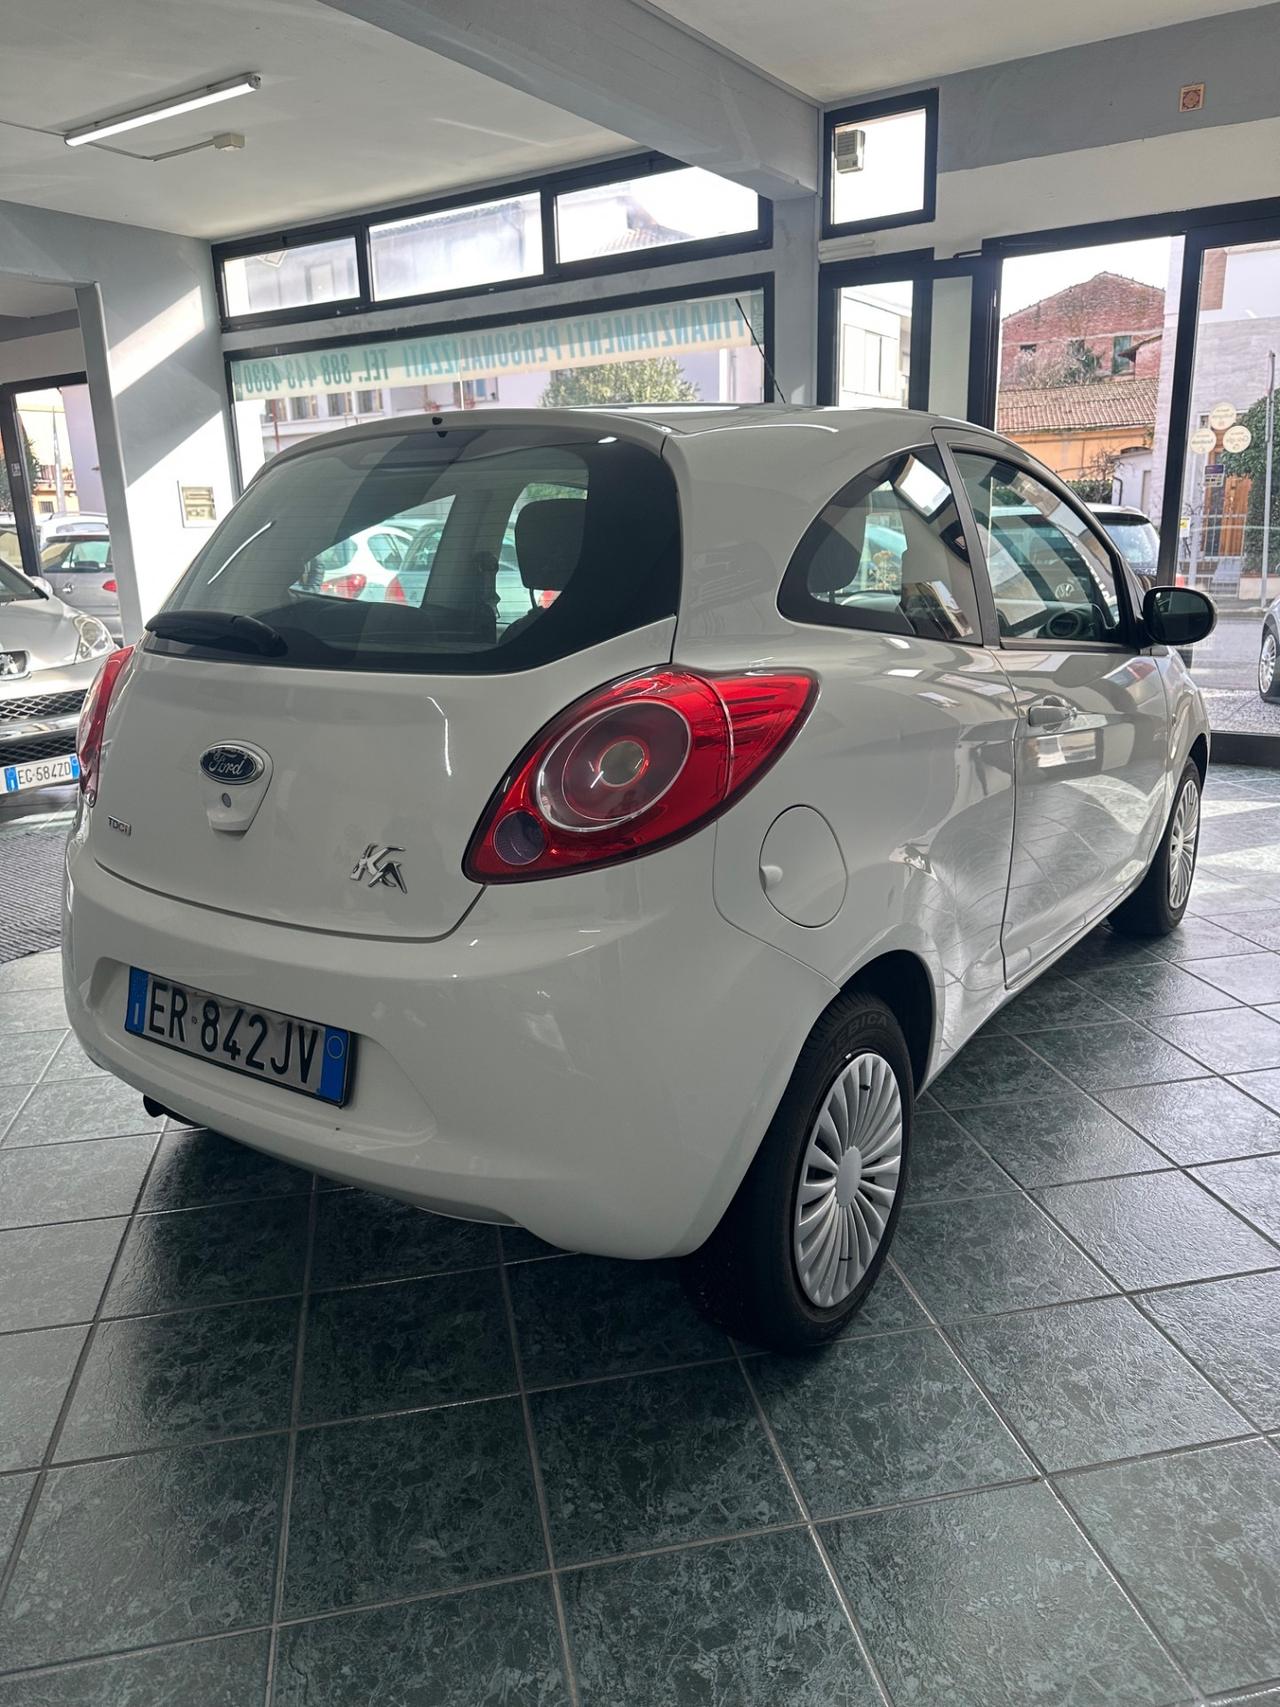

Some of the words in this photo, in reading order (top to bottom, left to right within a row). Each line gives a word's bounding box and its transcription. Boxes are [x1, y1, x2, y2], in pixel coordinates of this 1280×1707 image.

[207, 752, 246, 776] Ford
[149, 981, 188, 1042] ER
[200, 999, 319, 1084] 842JV
